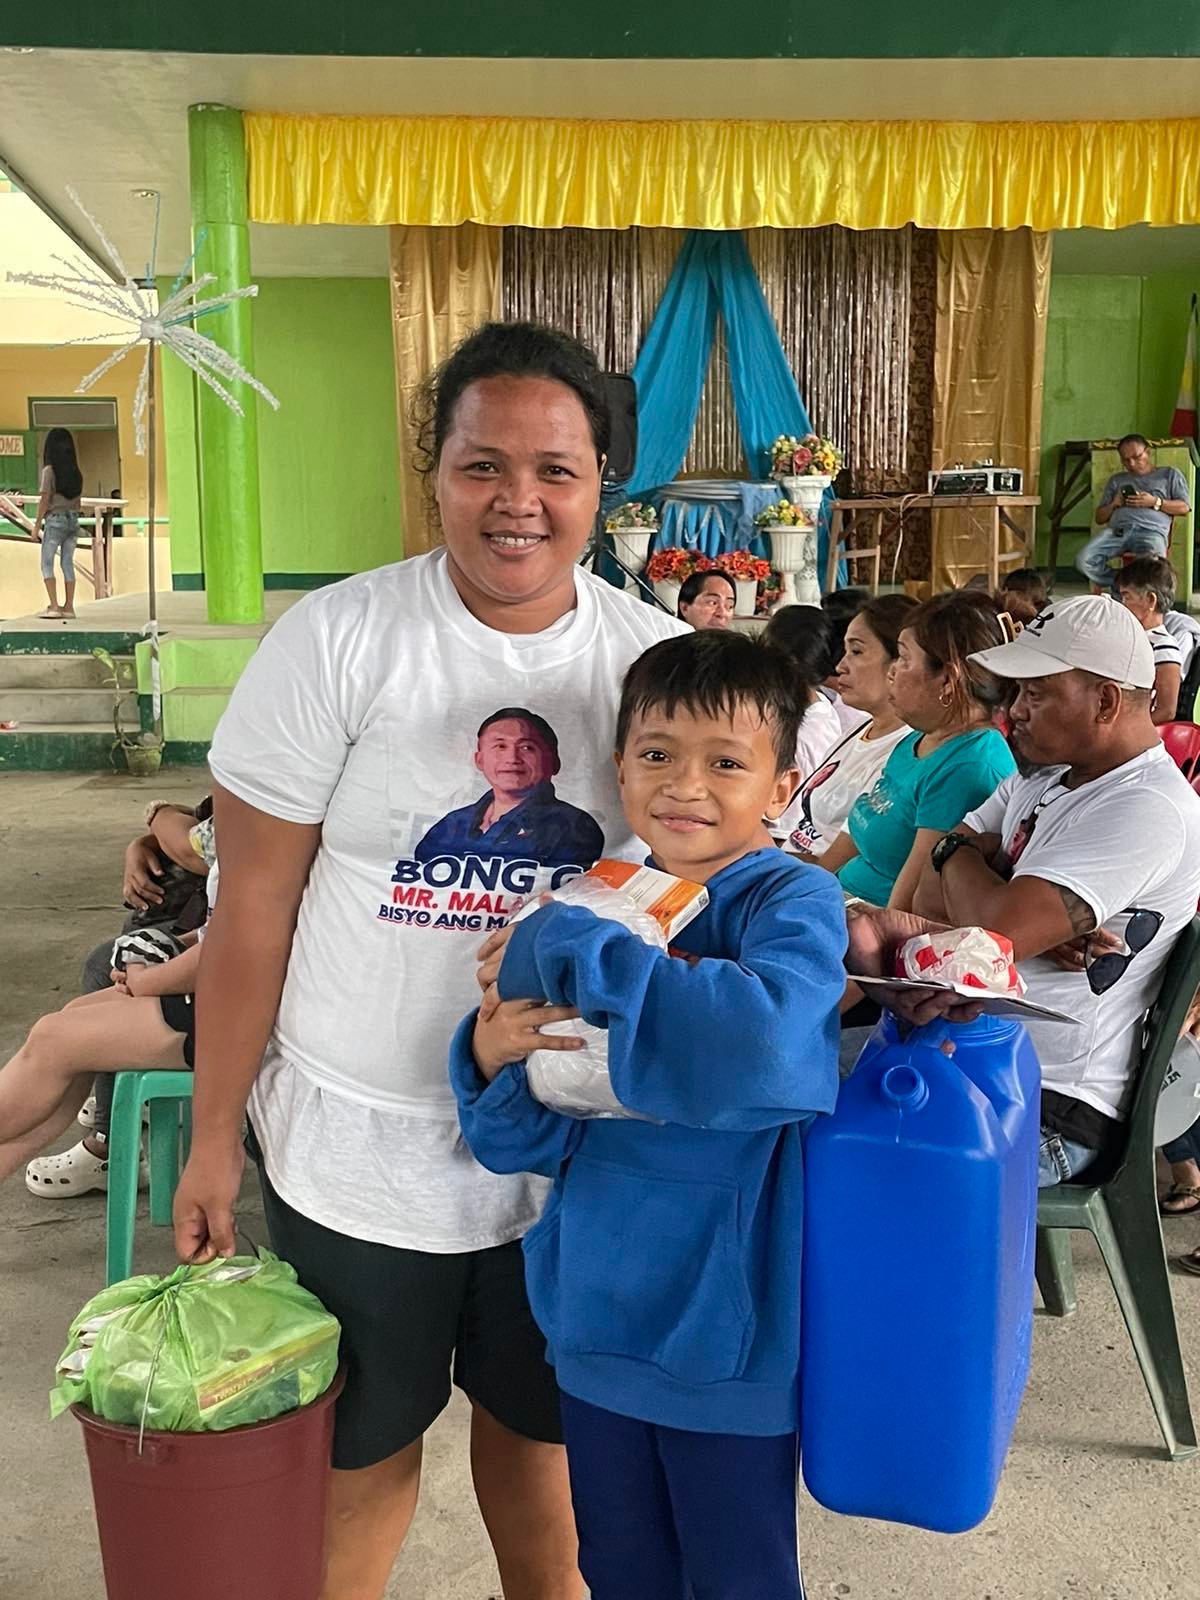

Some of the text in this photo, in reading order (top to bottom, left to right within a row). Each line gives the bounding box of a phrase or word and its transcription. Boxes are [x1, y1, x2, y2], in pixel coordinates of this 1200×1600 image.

[390, 855, 539, 895] BONG
[393, 885, 438, 909] MR.
[377, 904, 510, 932] BISYO ANG M
